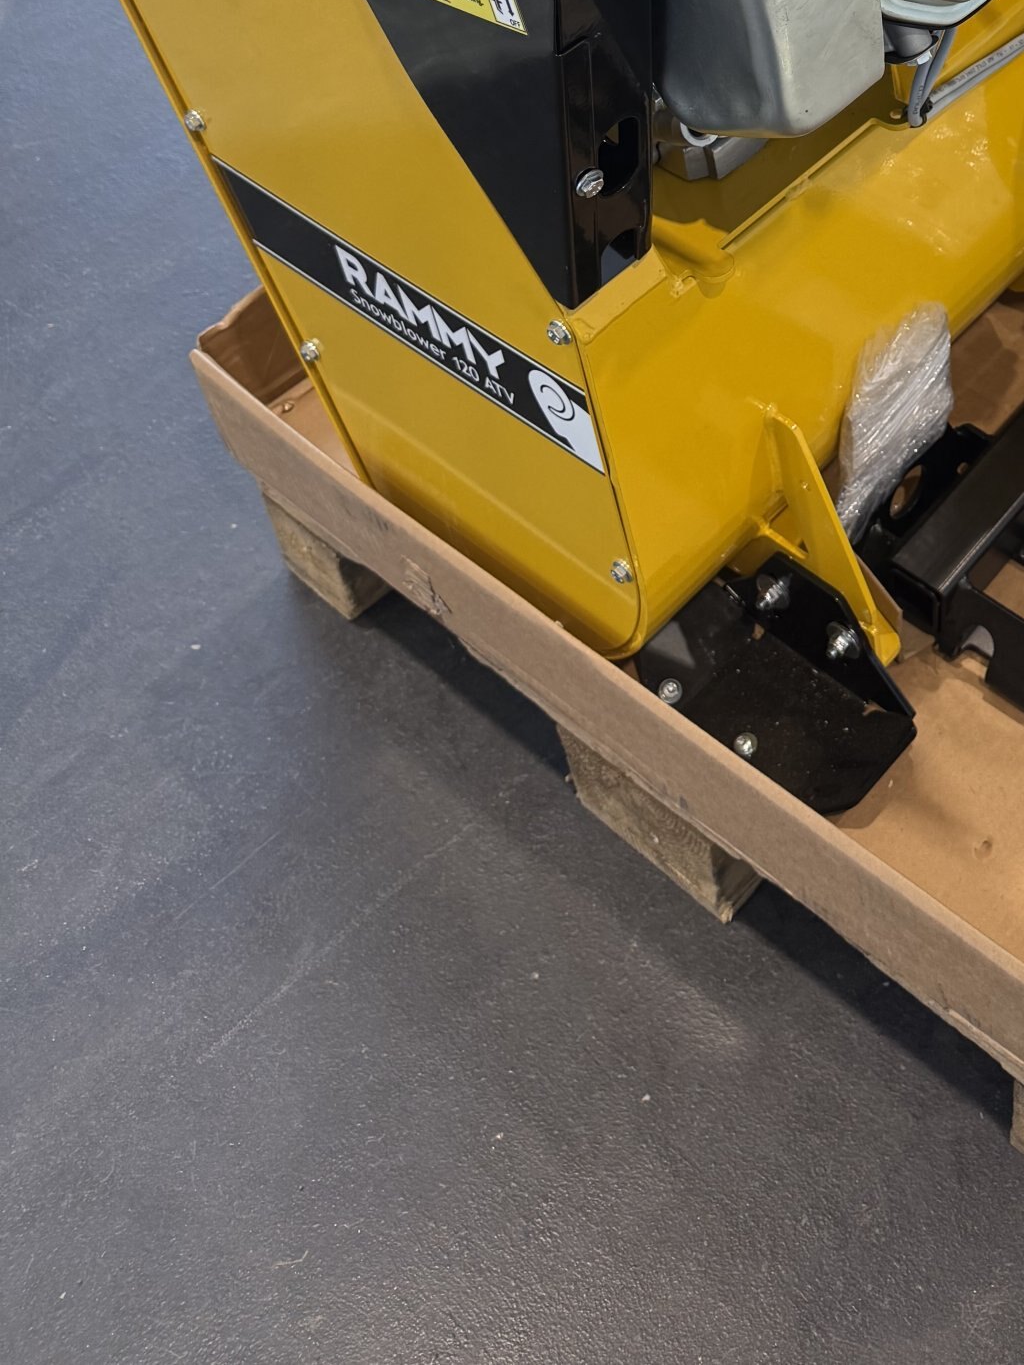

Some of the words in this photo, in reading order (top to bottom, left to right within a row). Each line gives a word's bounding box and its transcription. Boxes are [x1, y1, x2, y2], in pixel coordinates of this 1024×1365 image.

[335, 244, 506, 380] RAMMY
[349, 288, 447, 361] Snowblower
[451, 355, 481, 383] 120
[483, 376, 515, 406] ATV
